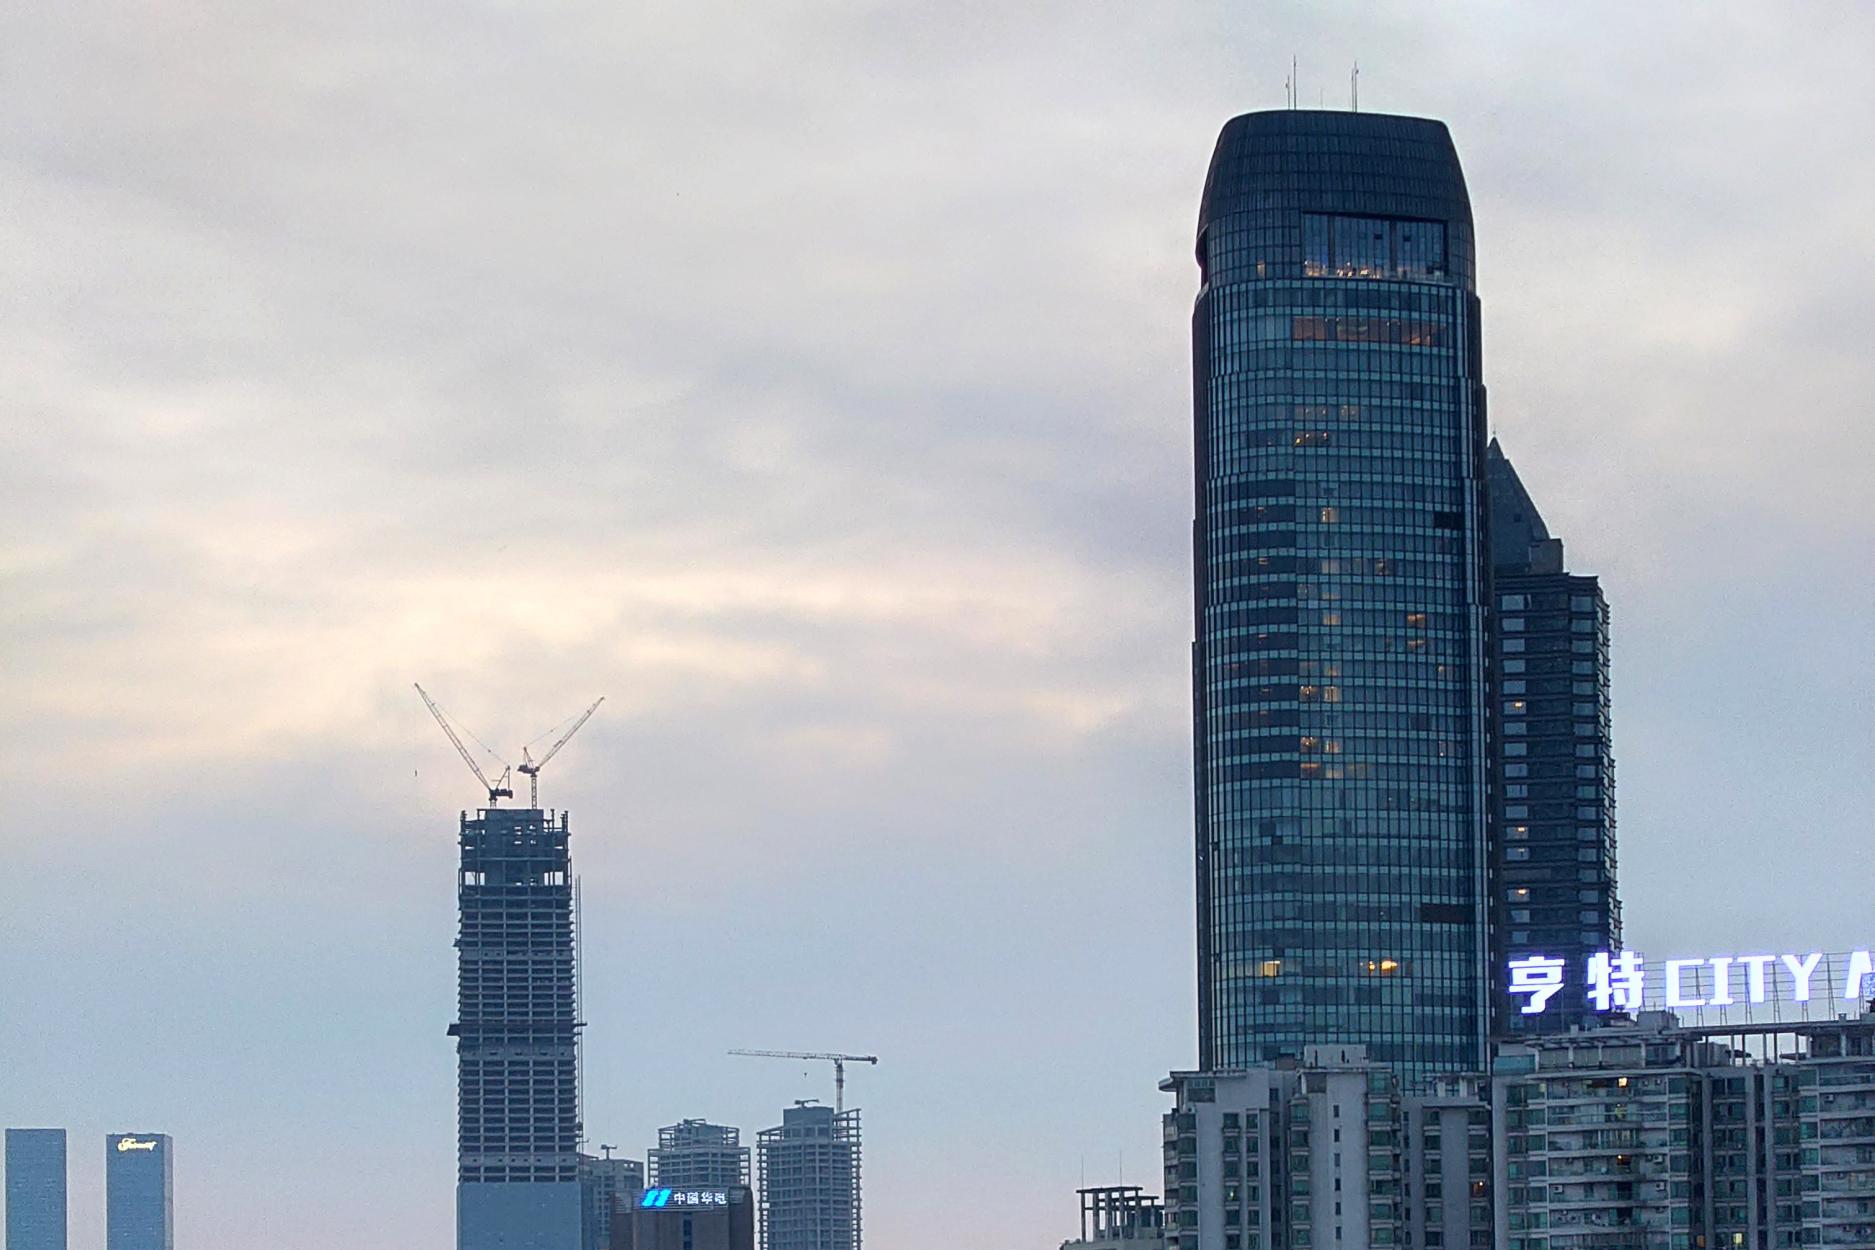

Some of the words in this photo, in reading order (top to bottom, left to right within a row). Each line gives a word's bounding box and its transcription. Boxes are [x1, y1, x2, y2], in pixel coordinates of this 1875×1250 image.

[1508, 950, 1645, 1014] 亨特
[1664, 953, 1823, 1007] CITY
[673, 1192, 727, 1205] 中国华电
